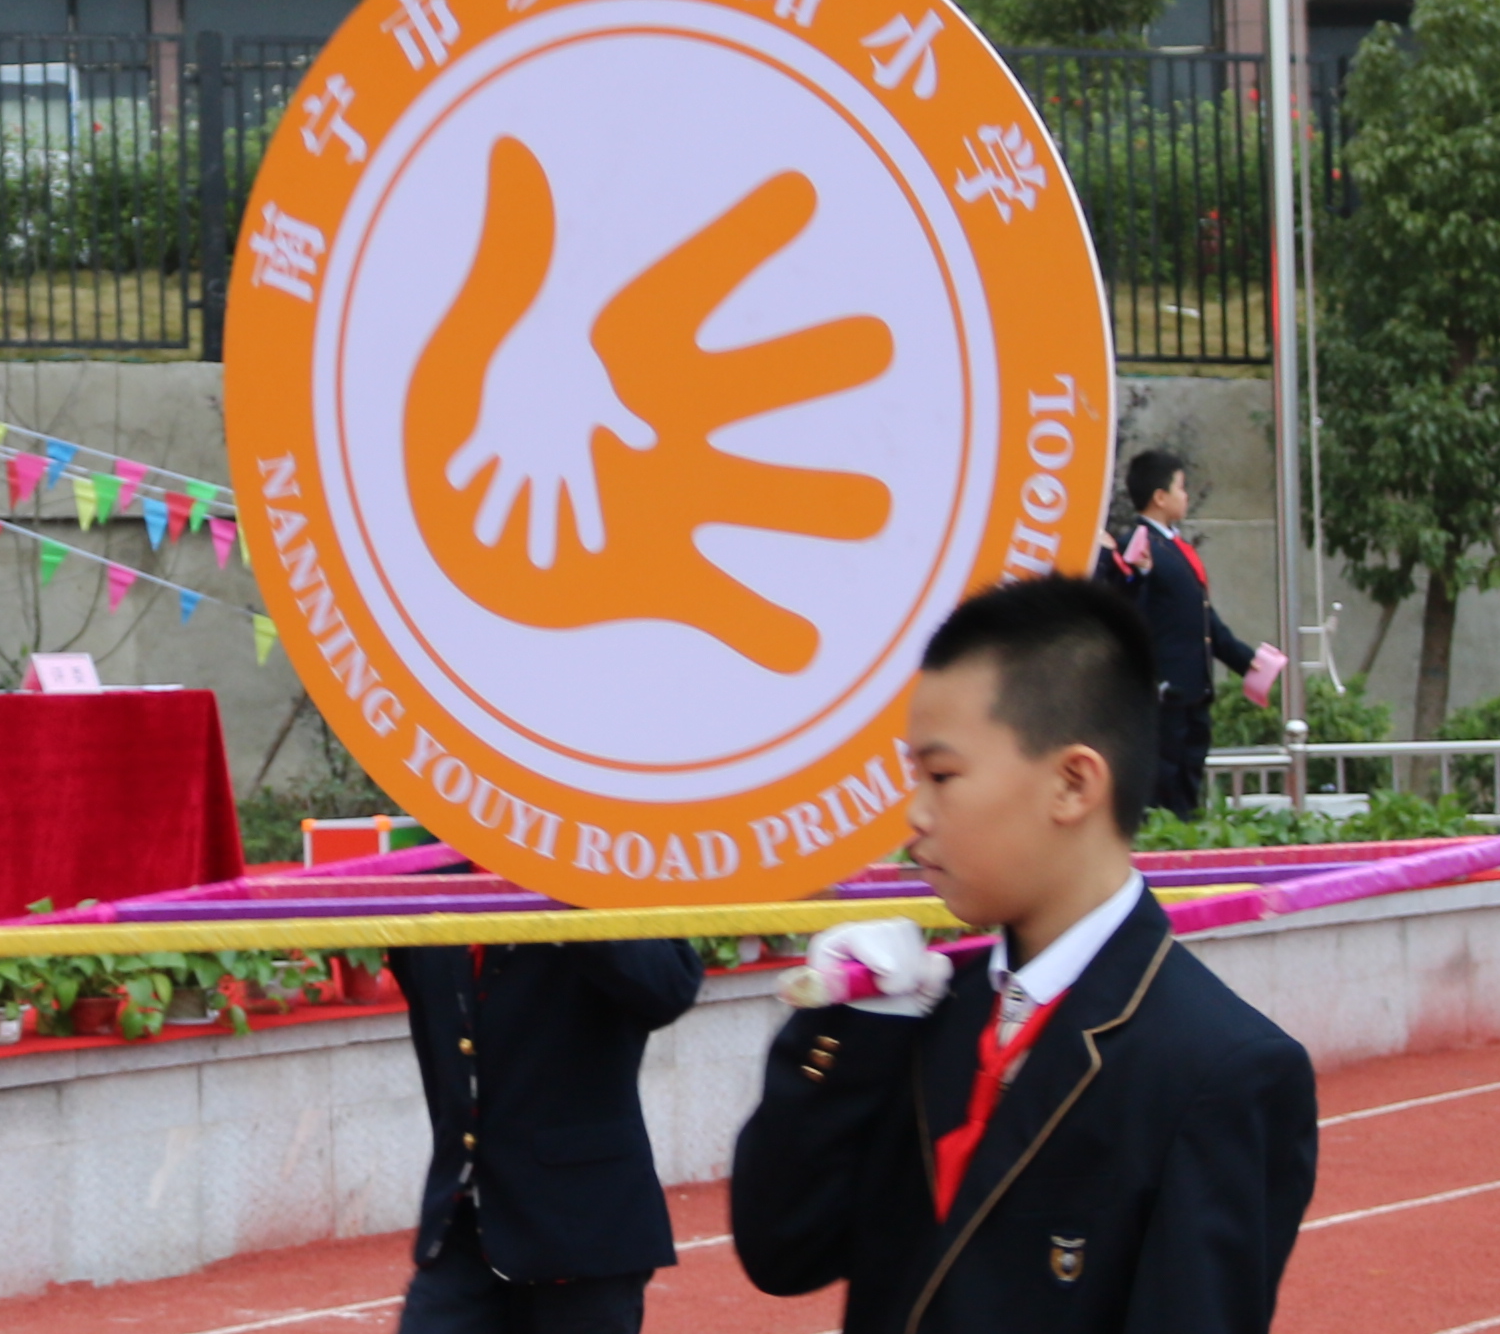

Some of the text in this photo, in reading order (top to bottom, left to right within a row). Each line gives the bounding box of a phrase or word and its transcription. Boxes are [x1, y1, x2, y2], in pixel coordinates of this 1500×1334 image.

[257, 450, 406, 739] NANNING
[402, 723, 564, 860] YOUYI
[572, 821, 741, 882] ROAD
